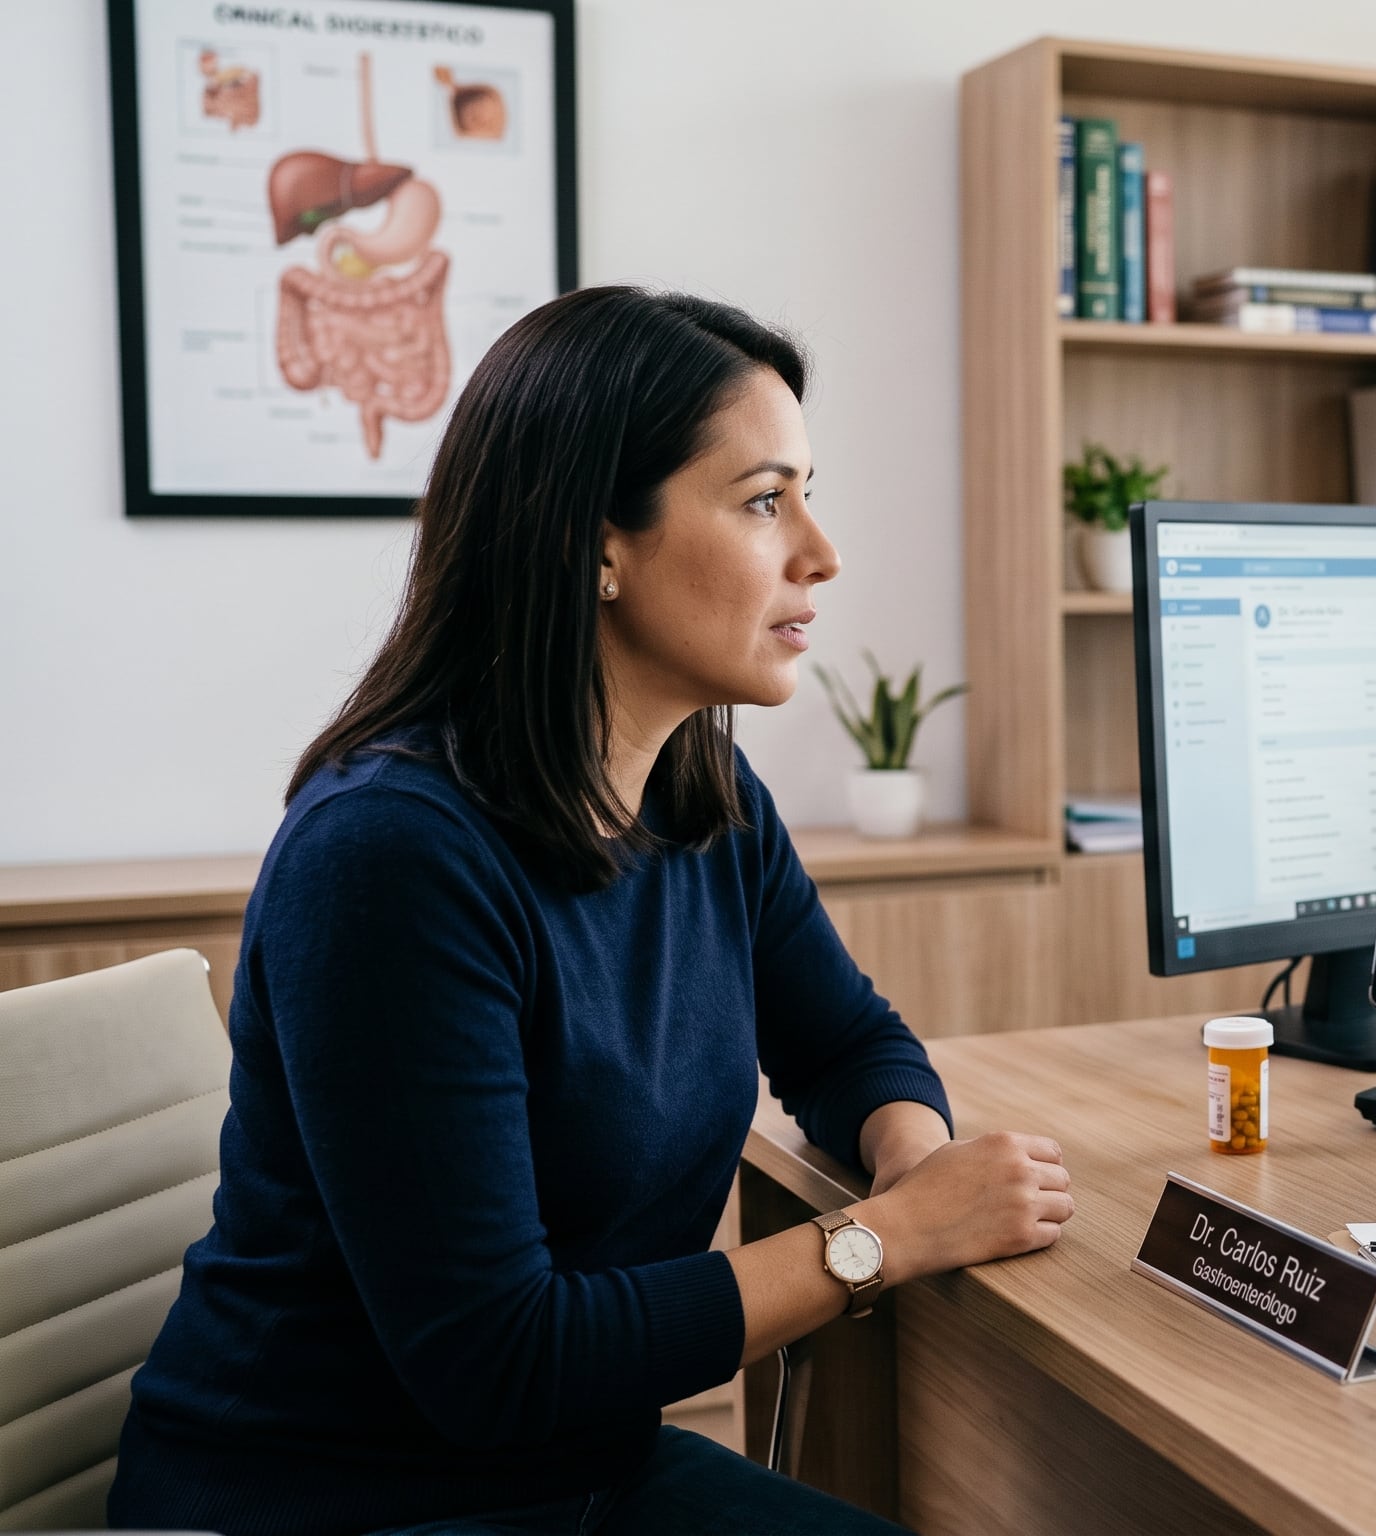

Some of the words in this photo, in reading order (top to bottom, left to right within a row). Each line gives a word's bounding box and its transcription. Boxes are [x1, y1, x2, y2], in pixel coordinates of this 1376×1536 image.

[1189, 1213, 1215, 1248] Dr.
[1220, 1227, 1278, 1278] Carlos
[1279, 1255, 1326, 1302] Ruiz
[1192, 1256, 1297, 1325] Gastroenterólogo
